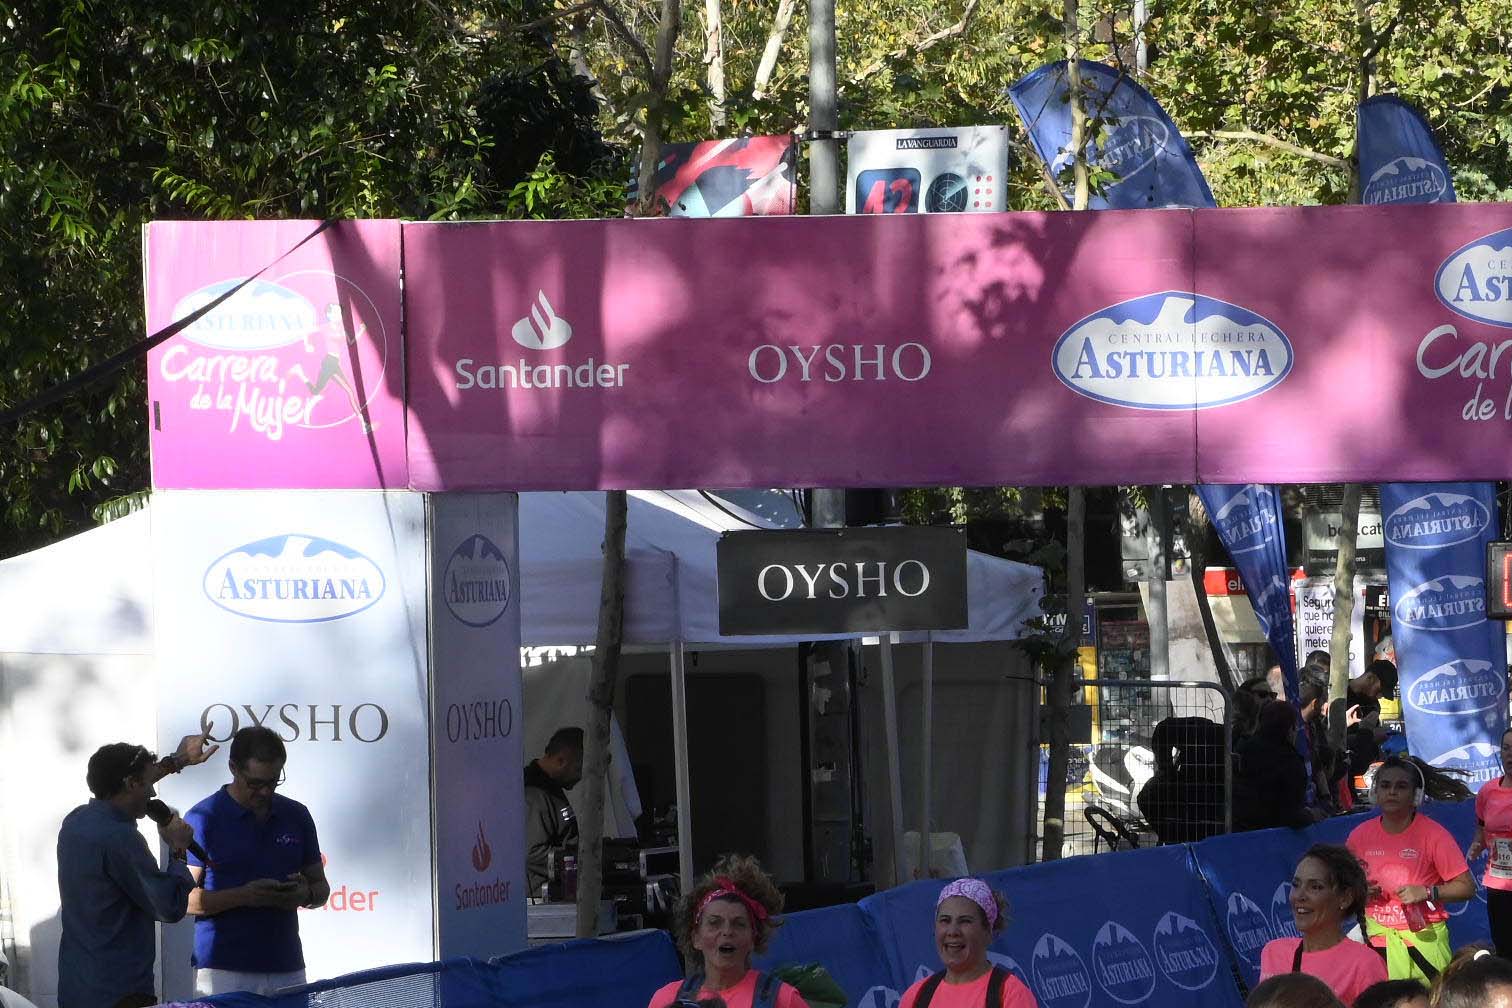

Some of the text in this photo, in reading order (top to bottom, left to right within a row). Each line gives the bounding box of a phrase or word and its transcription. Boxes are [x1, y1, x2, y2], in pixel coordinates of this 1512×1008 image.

[1108, 331, 1267, 346] CENTRAL LECHERA
[161, 345, 279, 382] Carrera
[455, 357, 629, 391] Santander
[747, 342, 932, 383] OYSHO
[1071, 336, 1275, 380] ASTURIANA
[230, 379, 324, 442] Mujer
[1462, 388, 1496, 420] de
[217, 567, 372, 601] ASTURIANA
[450, 570, 507, 604] ASTURIANA
[758, 560, 930, 603] OYSHO
[199, 702, 389, 744] OYSHO
[446, 698, 513, 744] OYSHO
[455, 878, 512, 911] Santander
[1037, 969, 1090, 1001] ASTURIANA
[1100, 957, 1153, 987] ASTURIANA
